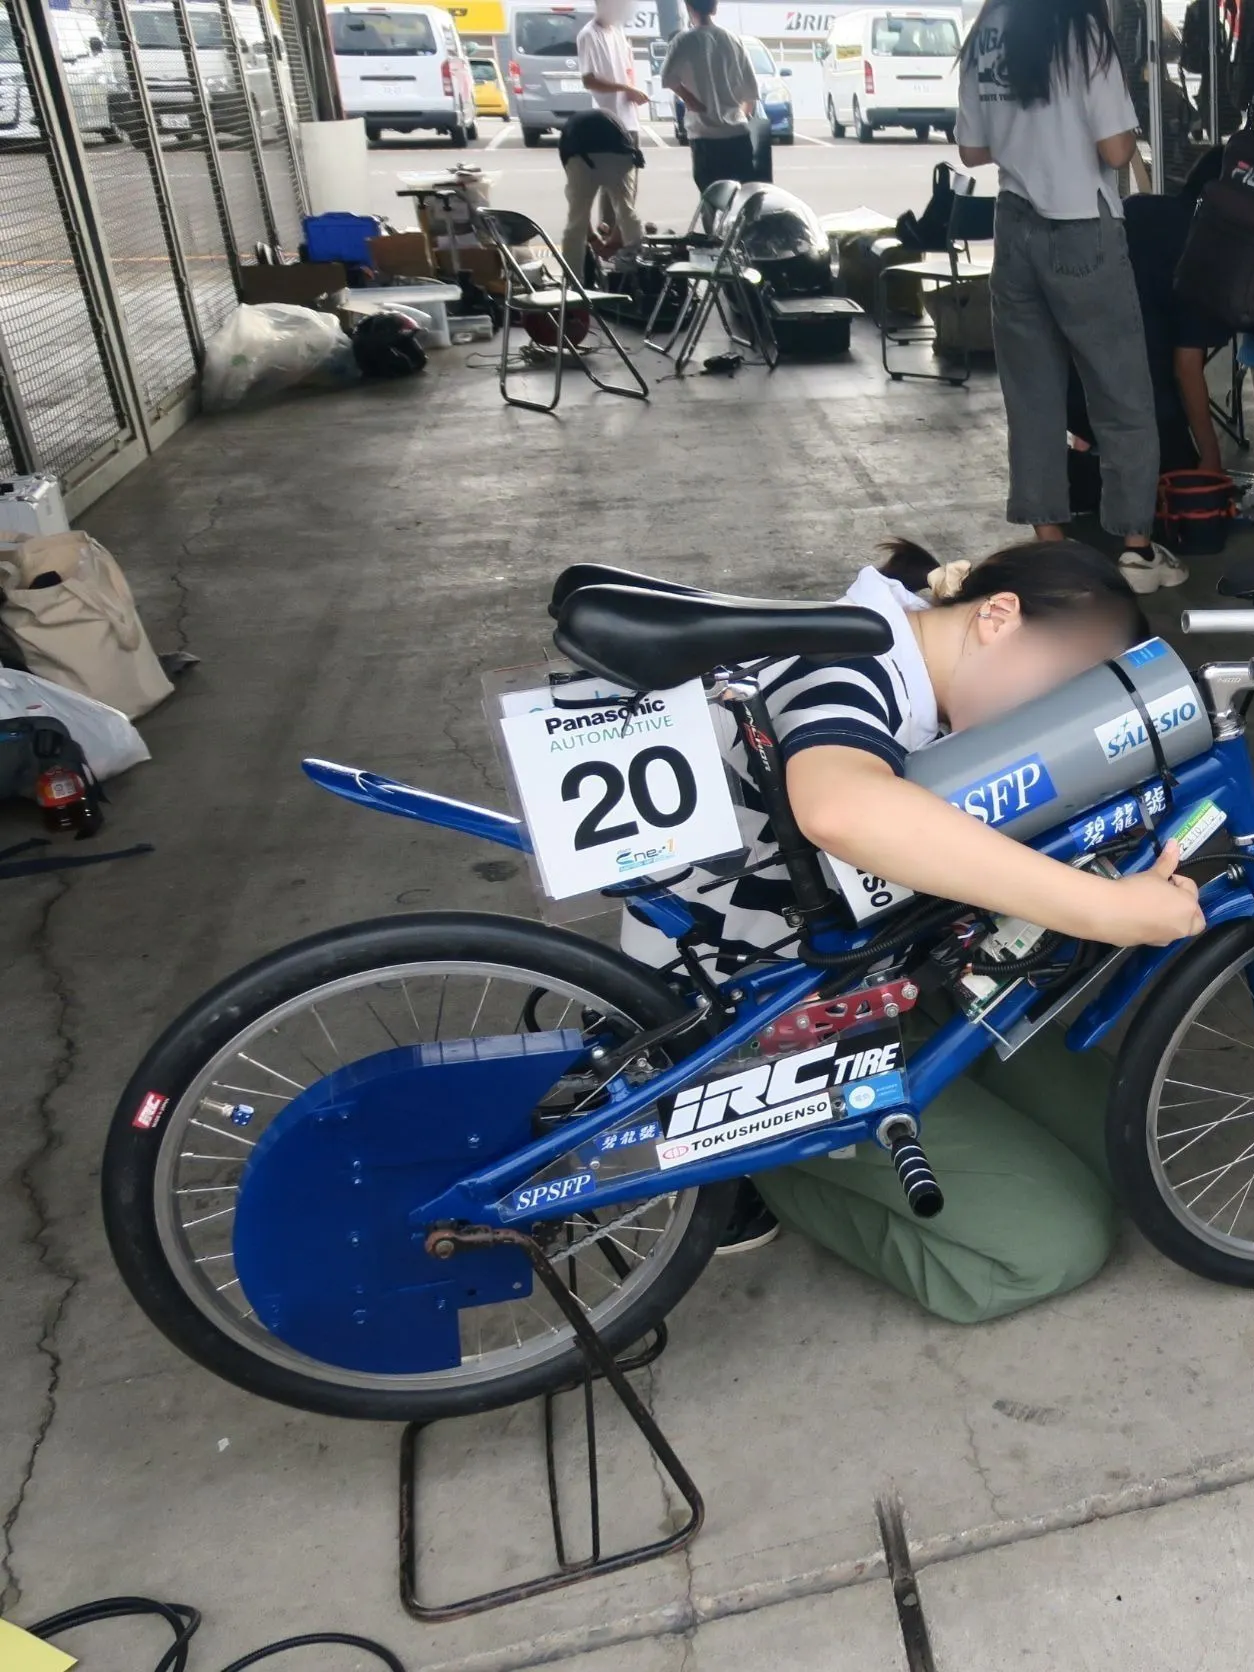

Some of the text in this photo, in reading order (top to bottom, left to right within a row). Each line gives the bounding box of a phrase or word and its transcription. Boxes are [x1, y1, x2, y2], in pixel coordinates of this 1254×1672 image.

[545, 698, 666, 735] Panasonic
[549, 714, 675, 753] AUTOMOTIVE
[560, 745, 698, 851] 20
[951, 762, 1041, 824] SFP
[856, 868, 893, 907] SO
[833, 1042, 900, 1086] TIRE
[691, 1101, 828, 1151] TOKUSHUDENSO
[516, 1174, 592, 1211] SPSFP
